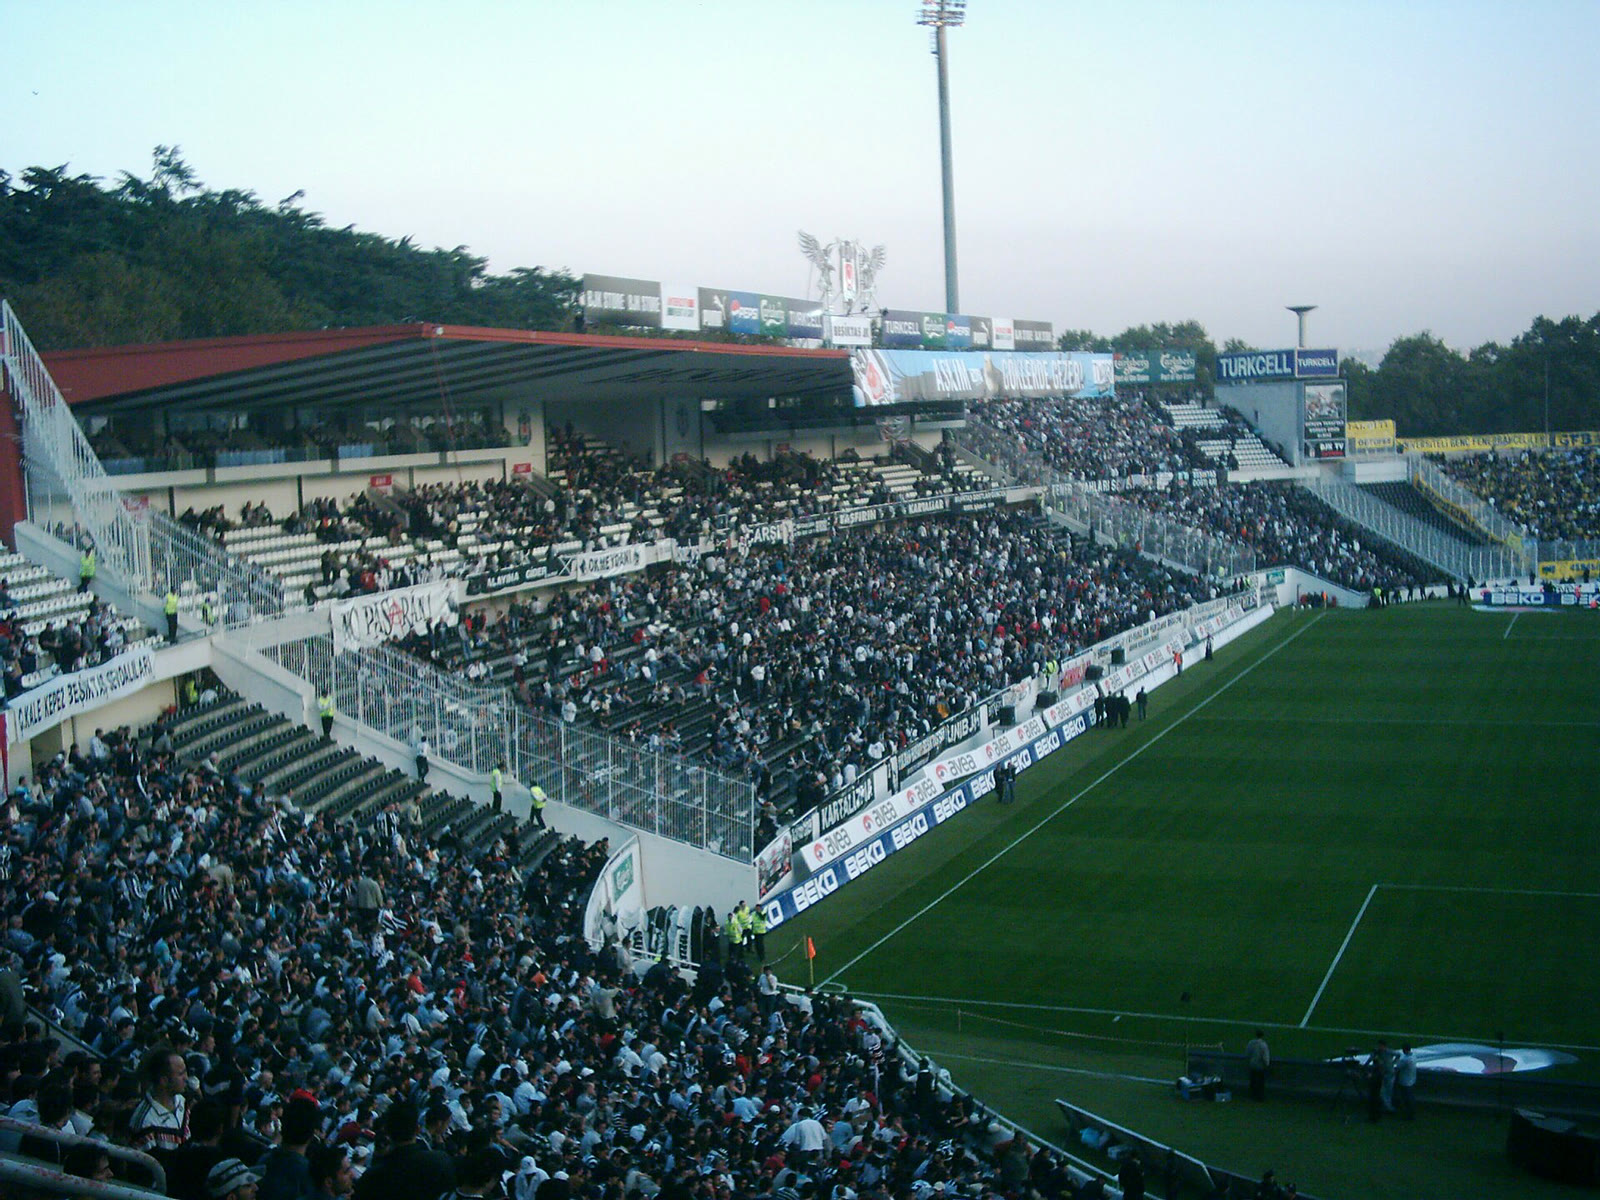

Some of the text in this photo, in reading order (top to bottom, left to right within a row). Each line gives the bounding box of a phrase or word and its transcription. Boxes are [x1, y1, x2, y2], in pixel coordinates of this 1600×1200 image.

[885, 320, 921, 335] TURKCELL
[1219, 353, 1292, 378] TURKCELL
[1297, 357, 1336, 368] TURKCELL
[1334, 442, 1344, 451] TV
[1491, 593, 1545, 605] BEKO
[44, 687, 66, 717] KEPEZ
[1055, 701, 1073, 720] avea
[1023, 719, 1041, 737] avea
[1062, 715, 1087, 742] BEKO
[992, 735, 1012, 754] avea
[1034, 731, 1060, 760] BEKO
[948, 754, 977, 777] avea
[914, 777, 938, 803] avea
[970, 770, 996, 800] BEK
[873, 801, 899, 828] avea
[933, 789, 967, 824] BEKO
[824, 828, 852, 856] avea
[892, 812, 928, 850] BEKO
[844, 839, 887, 880] BEKO
[792, 868, 839, 912] BEKO
